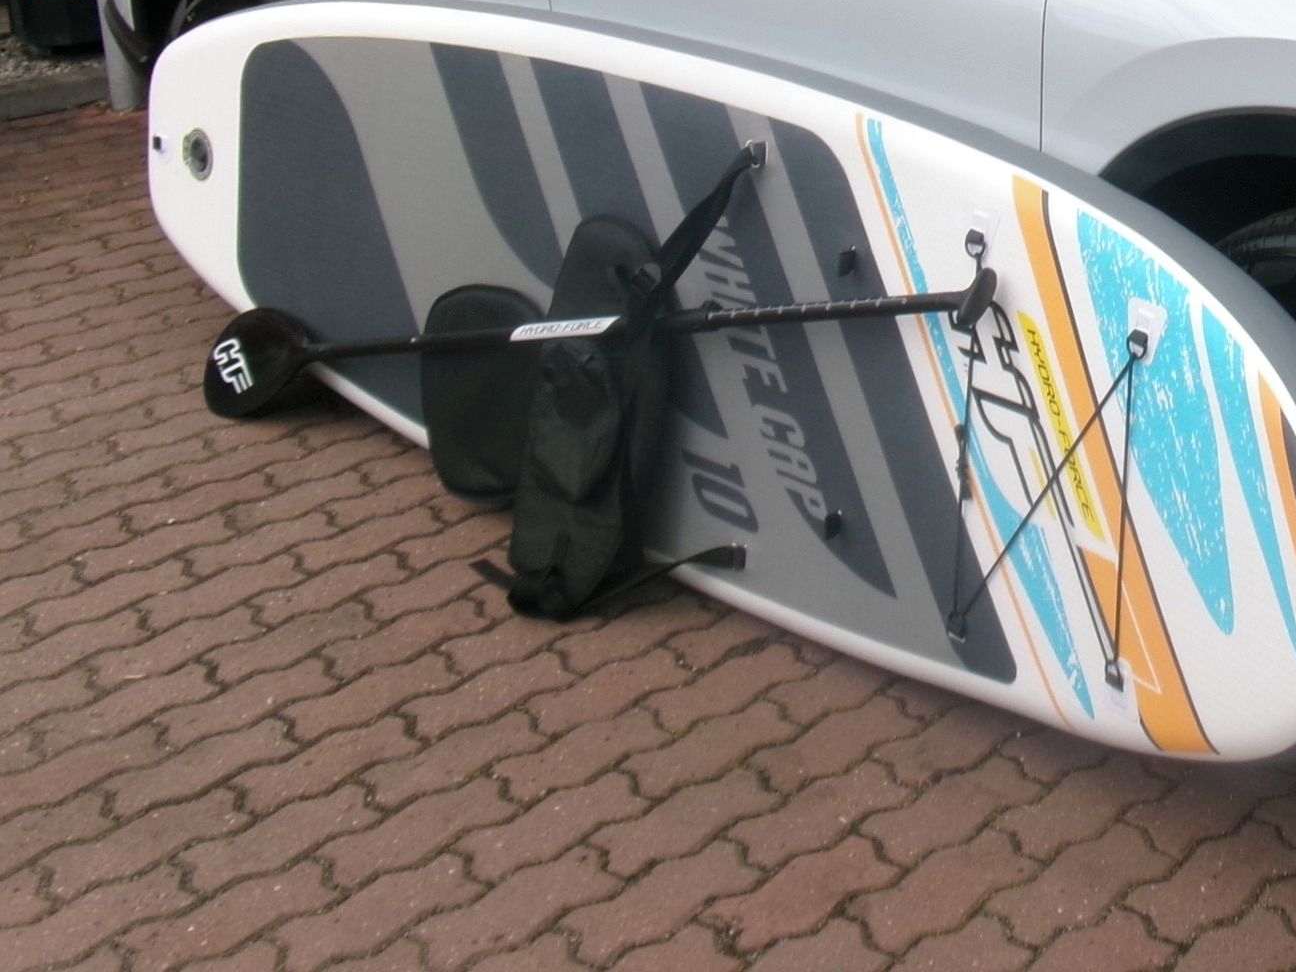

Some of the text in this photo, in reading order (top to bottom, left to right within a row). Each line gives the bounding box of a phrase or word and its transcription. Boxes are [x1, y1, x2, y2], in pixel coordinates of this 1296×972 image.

[752, 403, 829, 522] CAP
[1026, 328, 1095, 525] HYDRO-FORCE
[681, 447, 759, 534] 10
